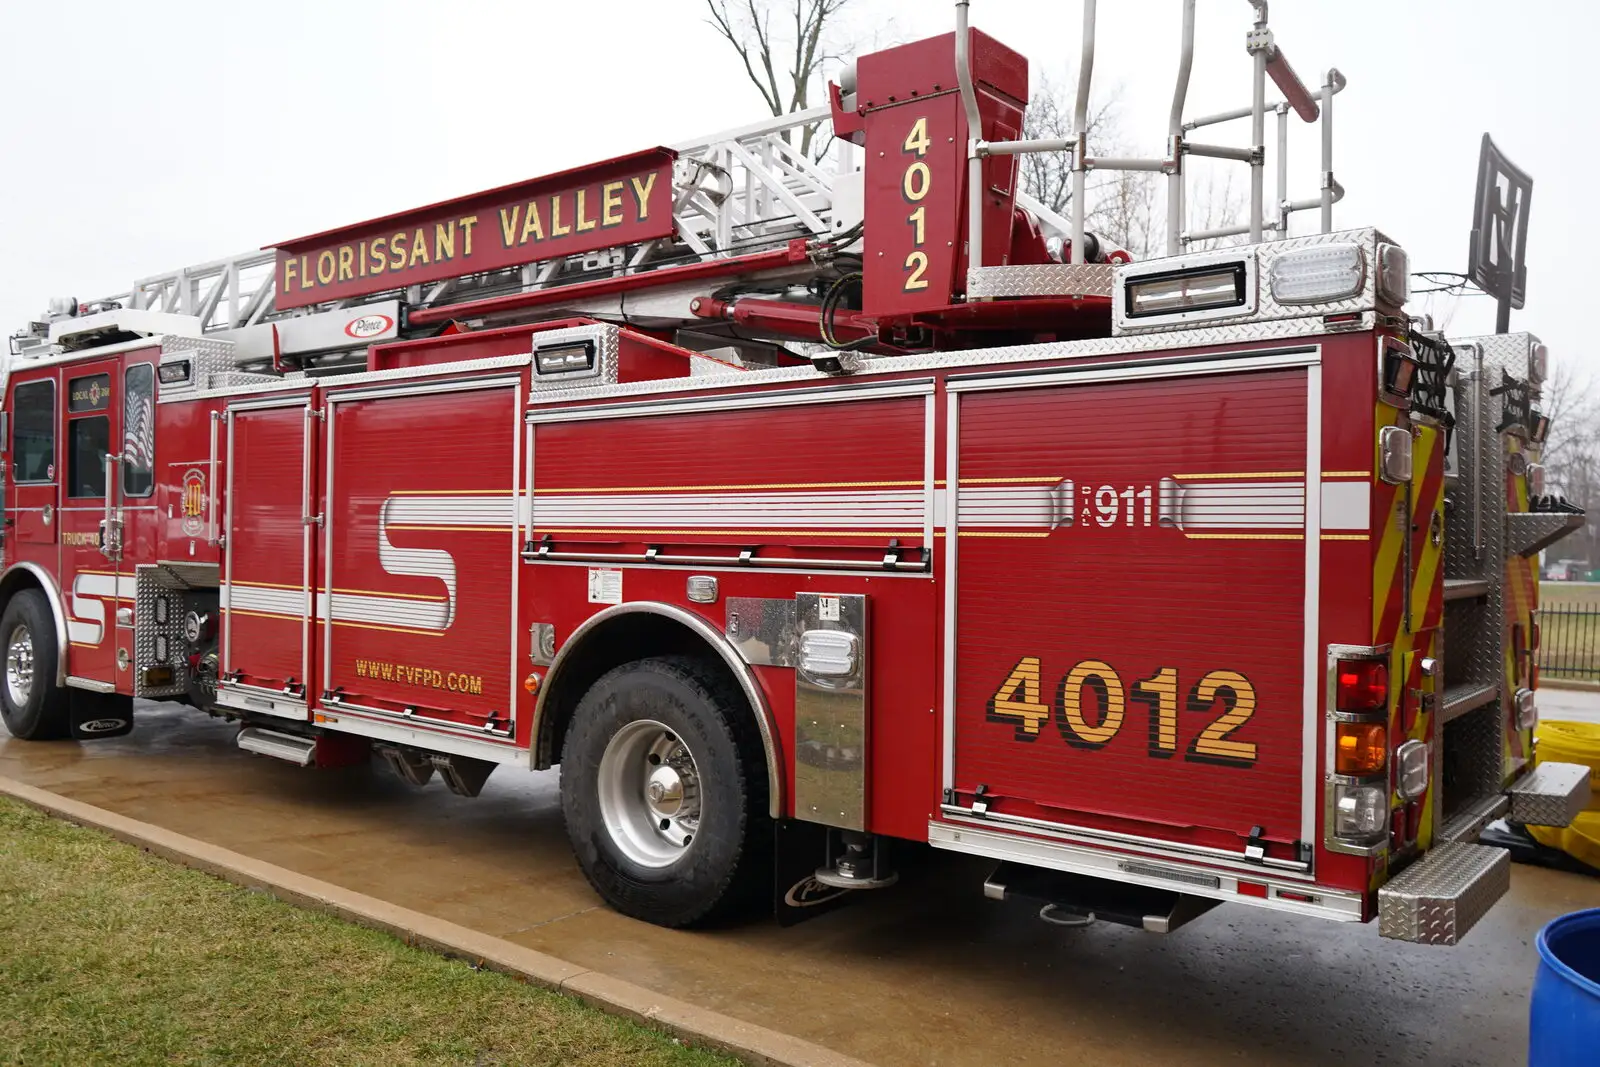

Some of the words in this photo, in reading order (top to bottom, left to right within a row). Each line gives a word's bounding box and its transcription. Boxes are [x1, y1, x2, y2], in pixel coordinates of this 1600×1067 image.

[903, 117, 931, 291] 4012
[283, 214, 479, 293] FLORISSANT
[499, 172, 658, 248] VALLEY
[354, 319, 382, 335] Pierce
[1081, 486, 1092, 527] DIAL
[1095, 484, 1152, 528] 911
[62, 531, 87, 546] TRUCK
[355, 659, 482, 694] WWW.FVFPD.COM
[988, 656, 1258, 767] 4012
